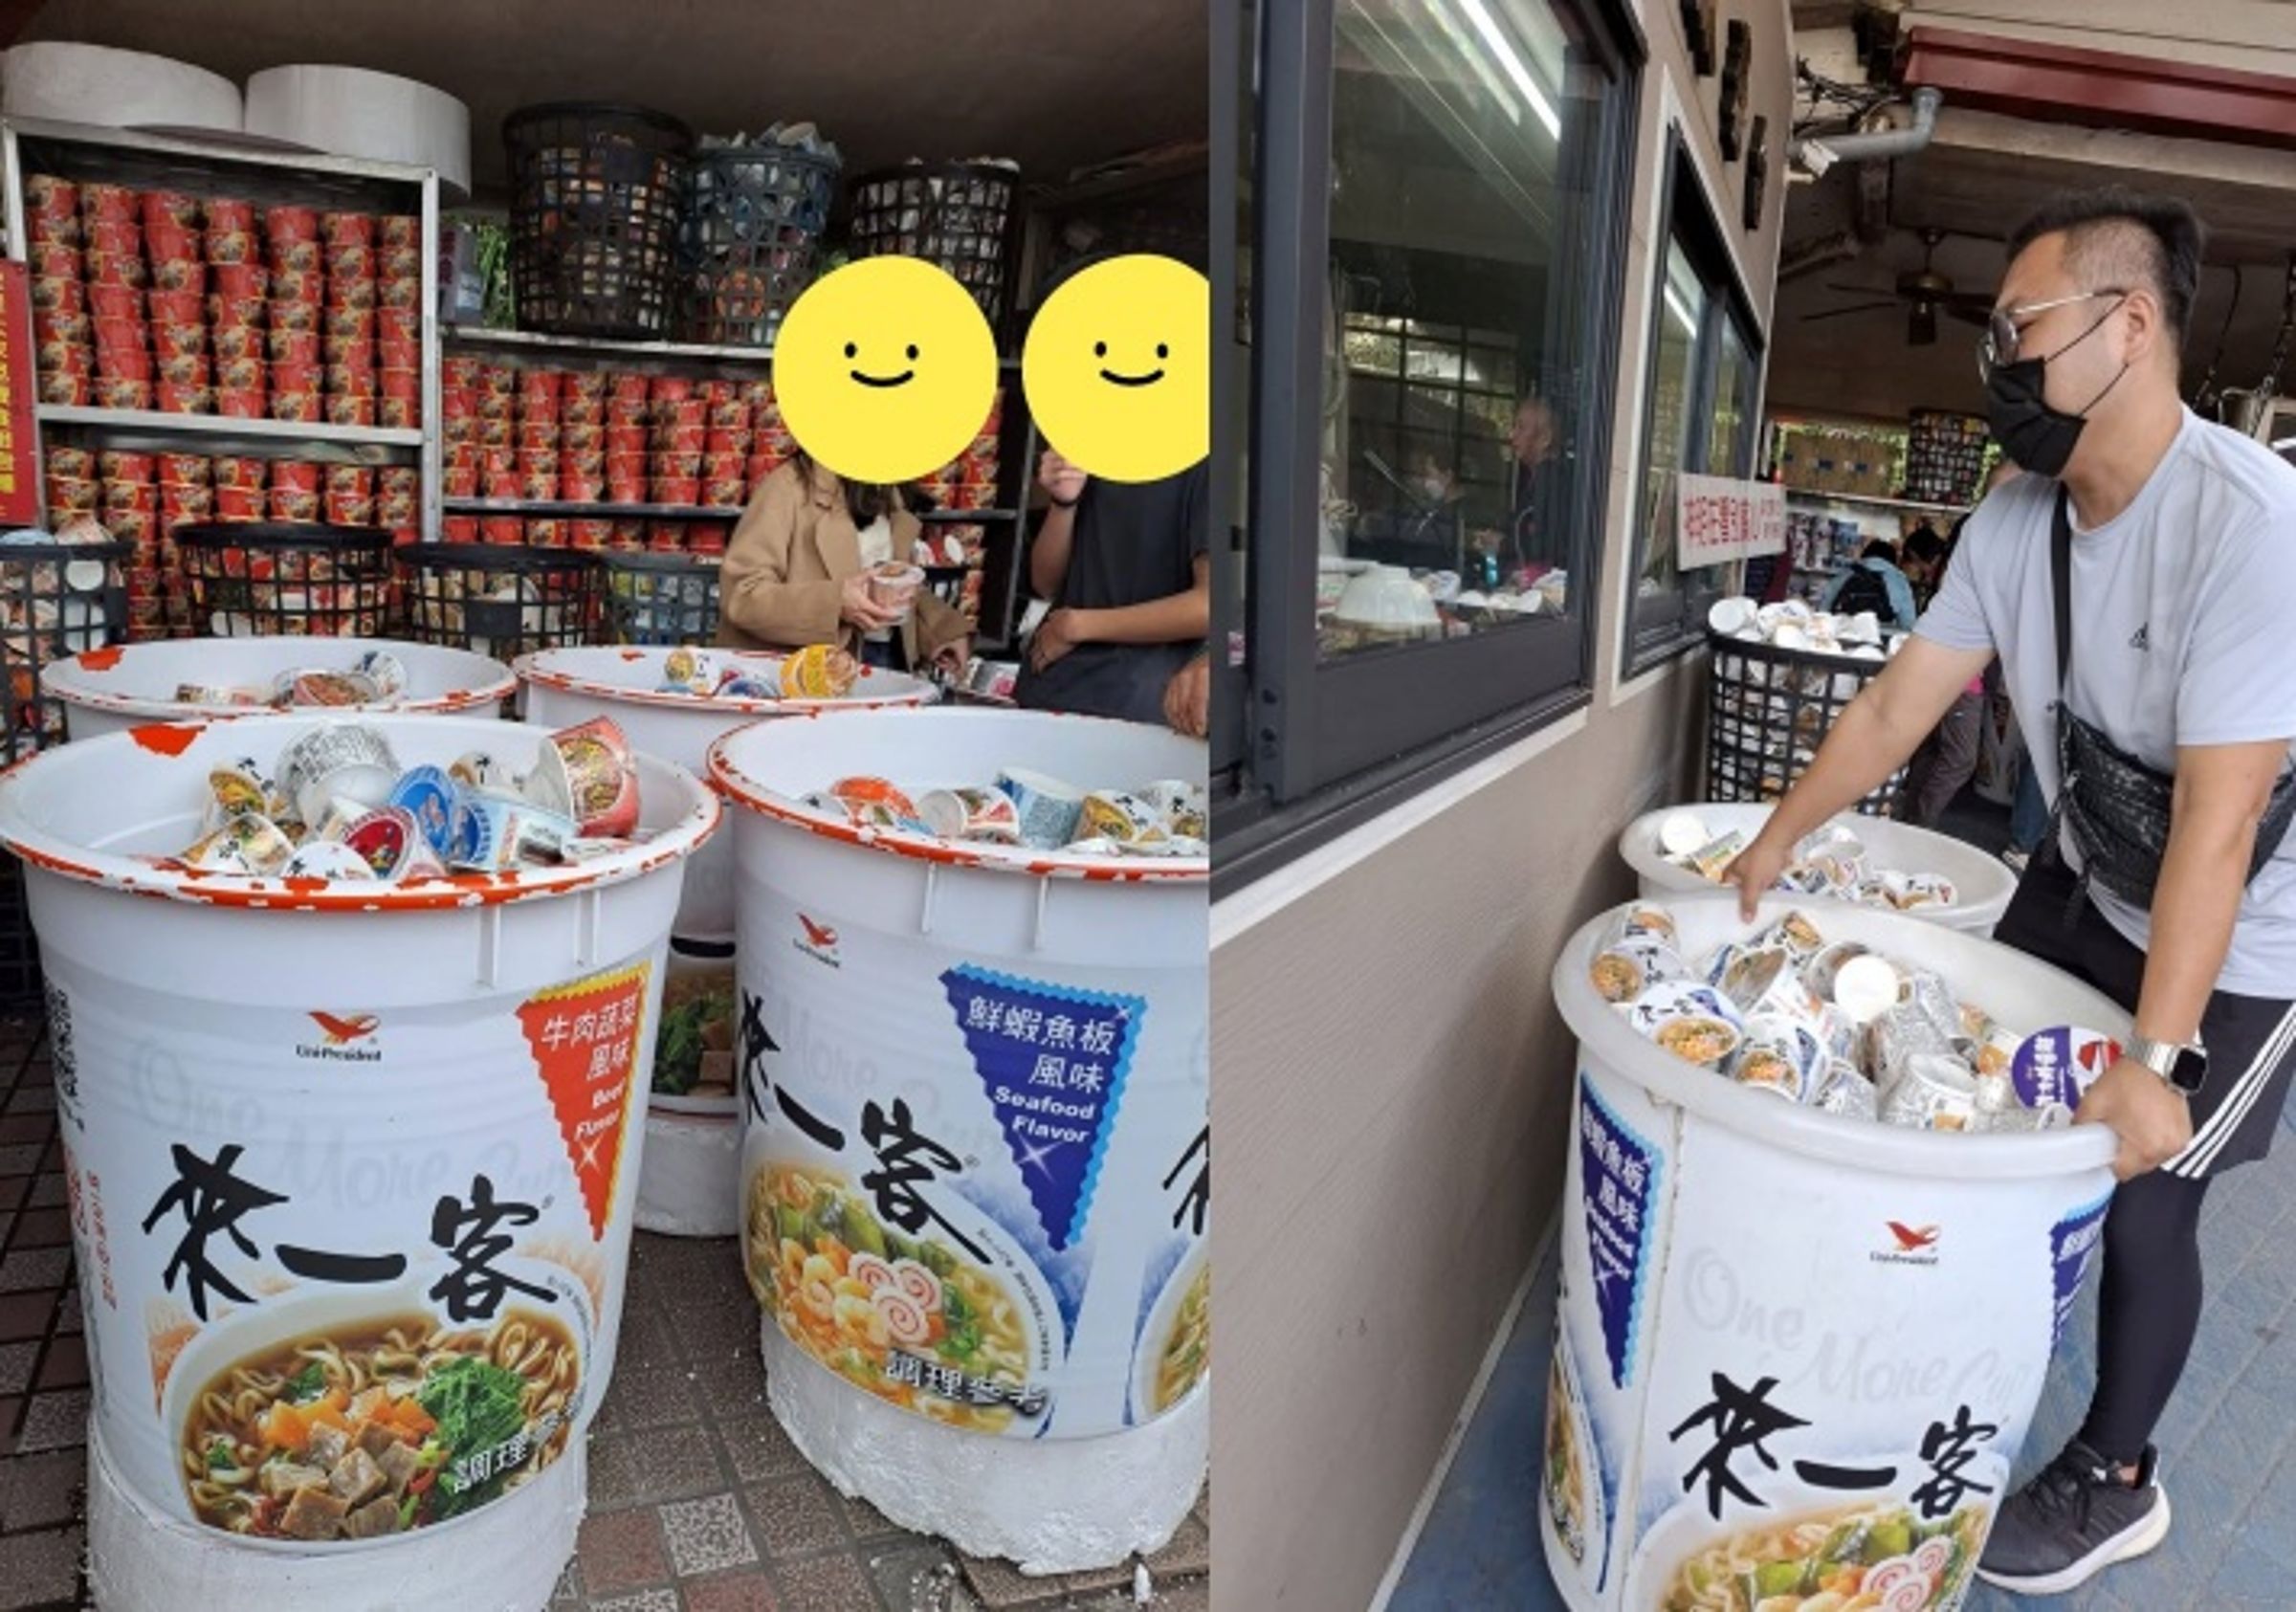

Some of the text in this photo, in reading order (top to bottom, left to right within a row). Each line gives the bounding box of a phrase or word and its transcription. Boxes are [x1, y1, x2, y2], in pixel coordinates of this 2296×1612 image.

[541, 992, 637, 1050] 牛肉蔬菜
[965, 996, 1116, 1055] 鮮蝦魚板
[296, 1044, 382, 1062] Uni-President
[586, 1037, 629, 1081] 風味
[1028, 1054, 1103, 1093] 風味
[994, 1086, 1096, 1120] Seafood
[1011, 1115, 1090, 1142] Flavor
[142, 1143, 558, 1322] 來一客
[1669, 1371, 1998, 1521] 來一客
